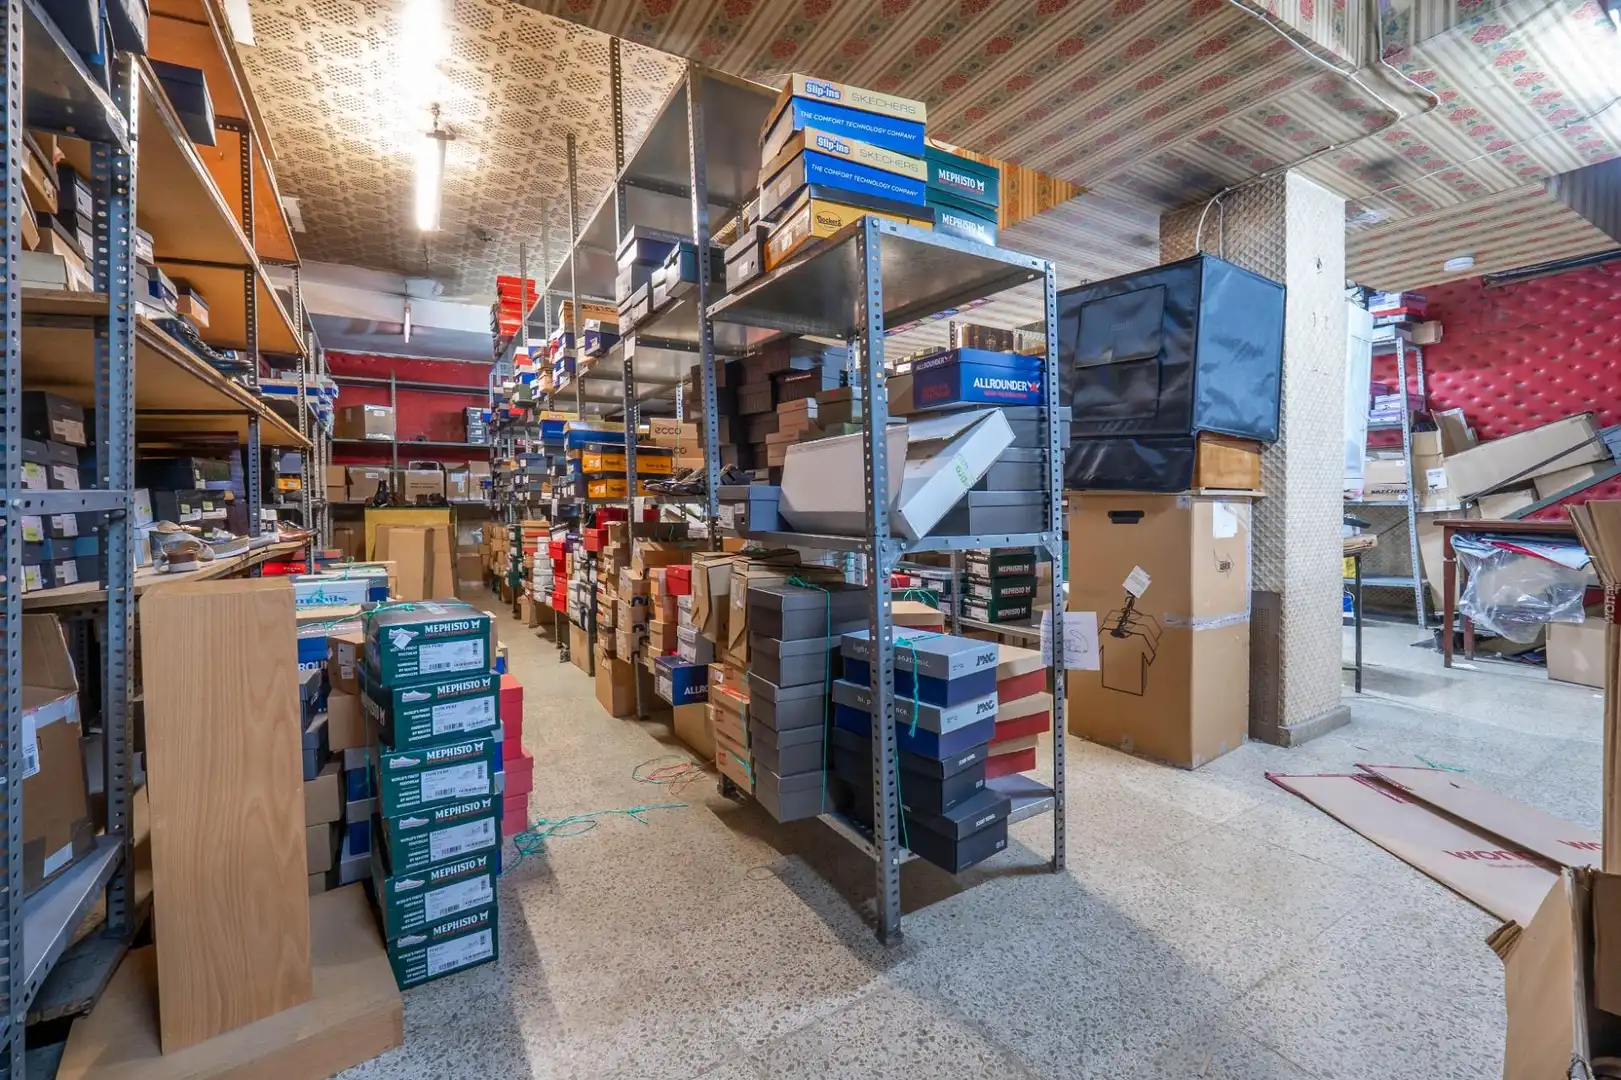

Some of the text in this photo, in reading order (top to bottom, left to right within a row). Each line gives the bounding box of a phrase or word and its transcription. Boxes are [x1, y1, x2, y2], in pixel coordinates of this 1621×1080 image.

[852, 92, 916, 114] SKECHERS
[800, 110, 917, 140] THE COMFORT TECHNOLOGY COMPANY
[860, 148, 919, 172] SKECHERS
[811, 163, 919, 197] THE COMFORT TECHNOLOGY COMPANY
[938, 168, 976, 189] MEPHISTO
[942, 212, 976, 233] MEPHISTO
[973, 377, 1027, 392] ALLROUNDER
[655, 426, 681, 435] ecco
[425, 621, 469, 634] MEPHISTO
[437, 680, 480, 694] MEPHISTO
[427, 744, 473, 760] MEPHISTO
[435, 802, 480, 819] MEPHISTO
[431, 860, 475, 880] MEPHISTO
[433, 914, 477, 936] MEPHISTO
